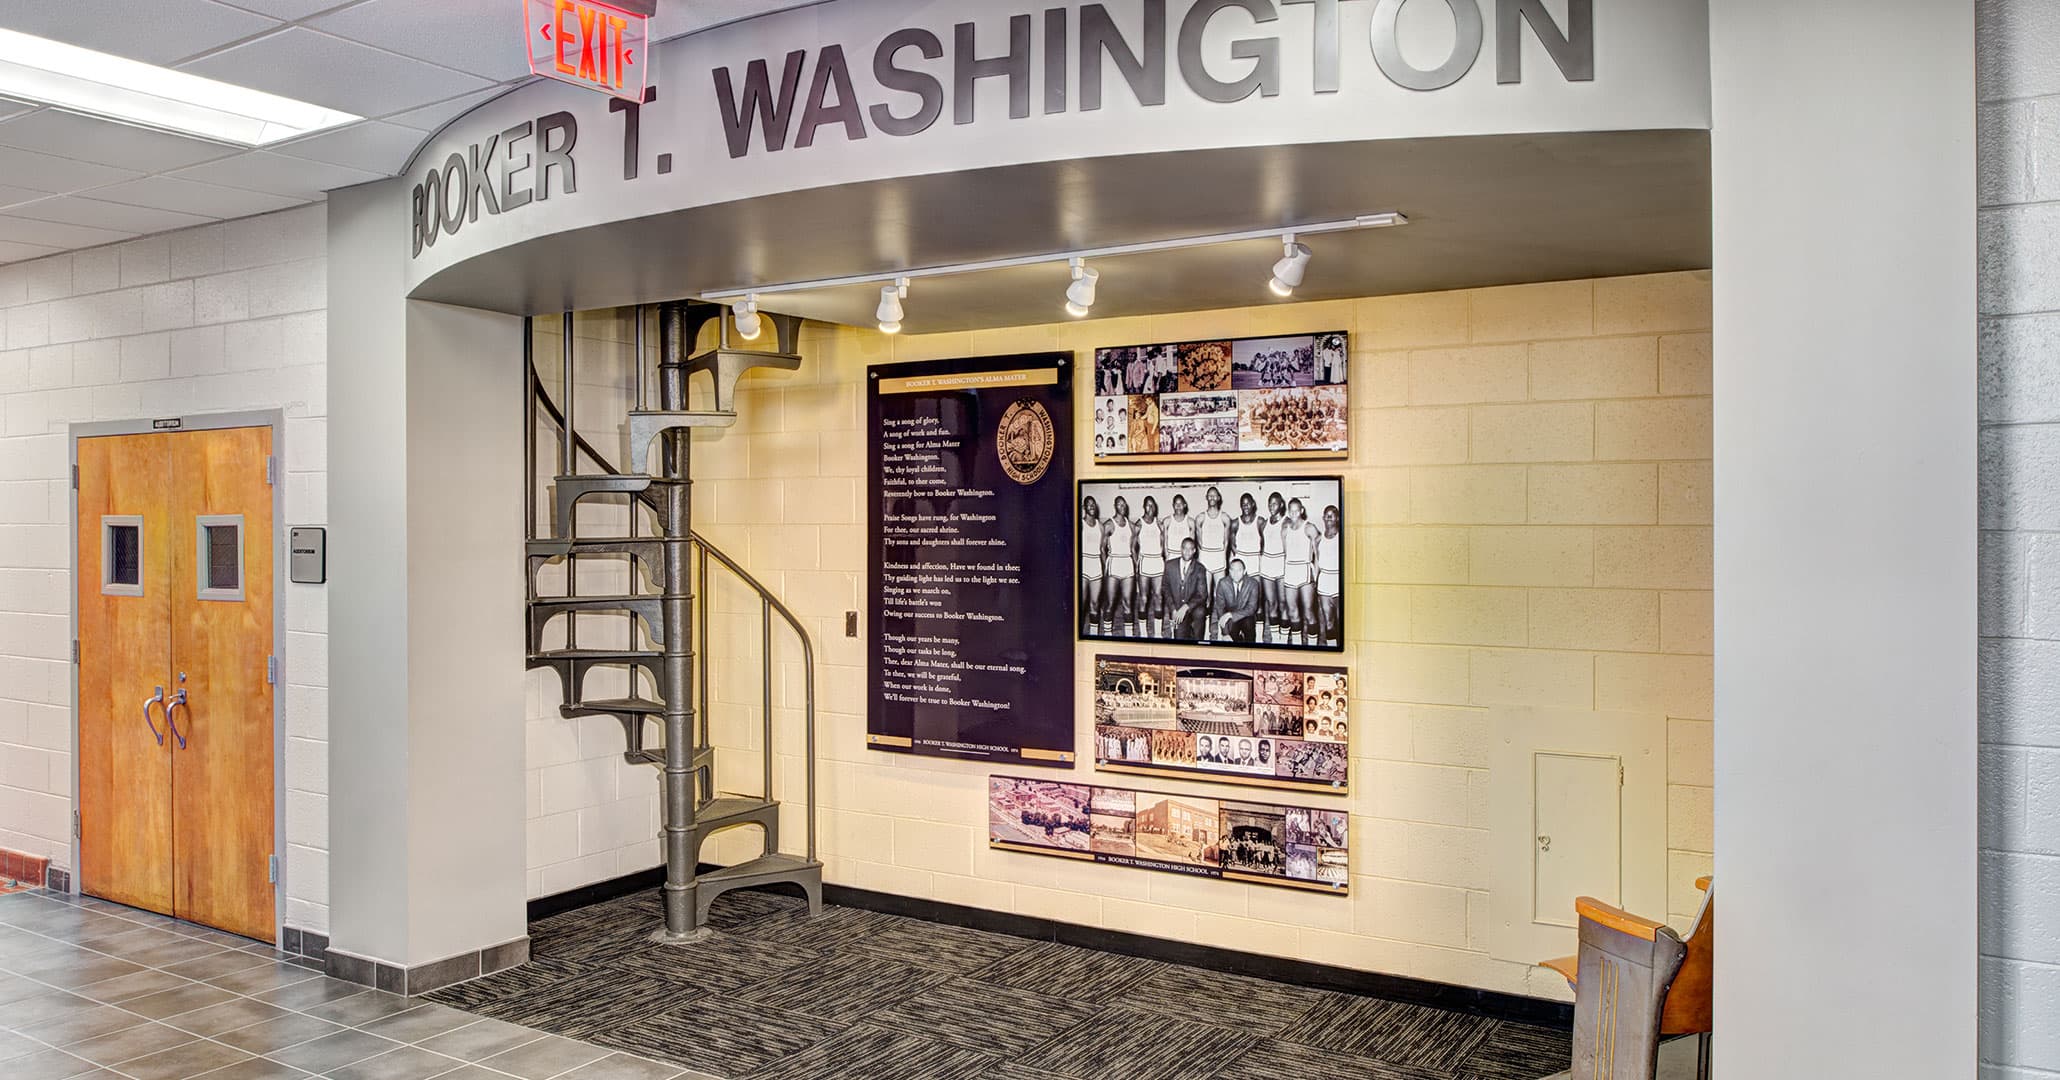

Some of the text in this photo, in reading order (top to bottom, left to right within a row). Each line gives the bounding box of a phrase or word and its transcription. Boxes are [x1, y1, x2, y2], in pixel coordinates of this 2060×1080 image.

[554, 0, 628, 89] EXIT
[411, 0, 1595, 260] BOOKER T. WASHINGTON
[905, 380, 931, 388] BOOKER
[986, 375, 1003, 383] ALMA
[1004, 374, 1027, 382] MATER
[884, 419, 896, 427] Sing
[998, 424, 1006, 460] BOOKER
[1039, 409, 1053, 464] WASHINGTON
[884, 443, 896, 451] Sing
[942, 440, 960, 448] Mater
[896, 466, 905, 474] thy
[1021, 466, 1044, 480] SCHOOL
[884, 490, 912, 498] Reverently
[901, 514, 917, 523] Songs
[960, 514, 996, 523] Washington
[884, 538, 895, 546] Thy
[922, 538, 949, 547] daughters
[977, 563, 995, 571] found
[884, 574, 895, 582] Thy
[896, 574, 918, 583] guiding
[919, 575, 932, 583] light
[983, 576, 997, 585] light
[884, 586, 904, 594] Singing
[884, 610, 902, 618] Owing
[884, 633, 905, 643] Though
[884, 645, 905, 655] Though
[951, 661, 964, 669] shall
[884, 681, 900, 689] When
[899, 694, 918, 702] forever
[949, 698, 970, 706] Booker
[972, 699, 1010, 710] Washington!
[945, 741, 976, 749] WASHINGTON
[1108, 856, 1129, 864] BOOKER
[1135, 860, 1170, 869] WASHINGTON
[1171, 864, 1185, 872] HIGH
[1186, 864, 1209, 874] SCHOOL
